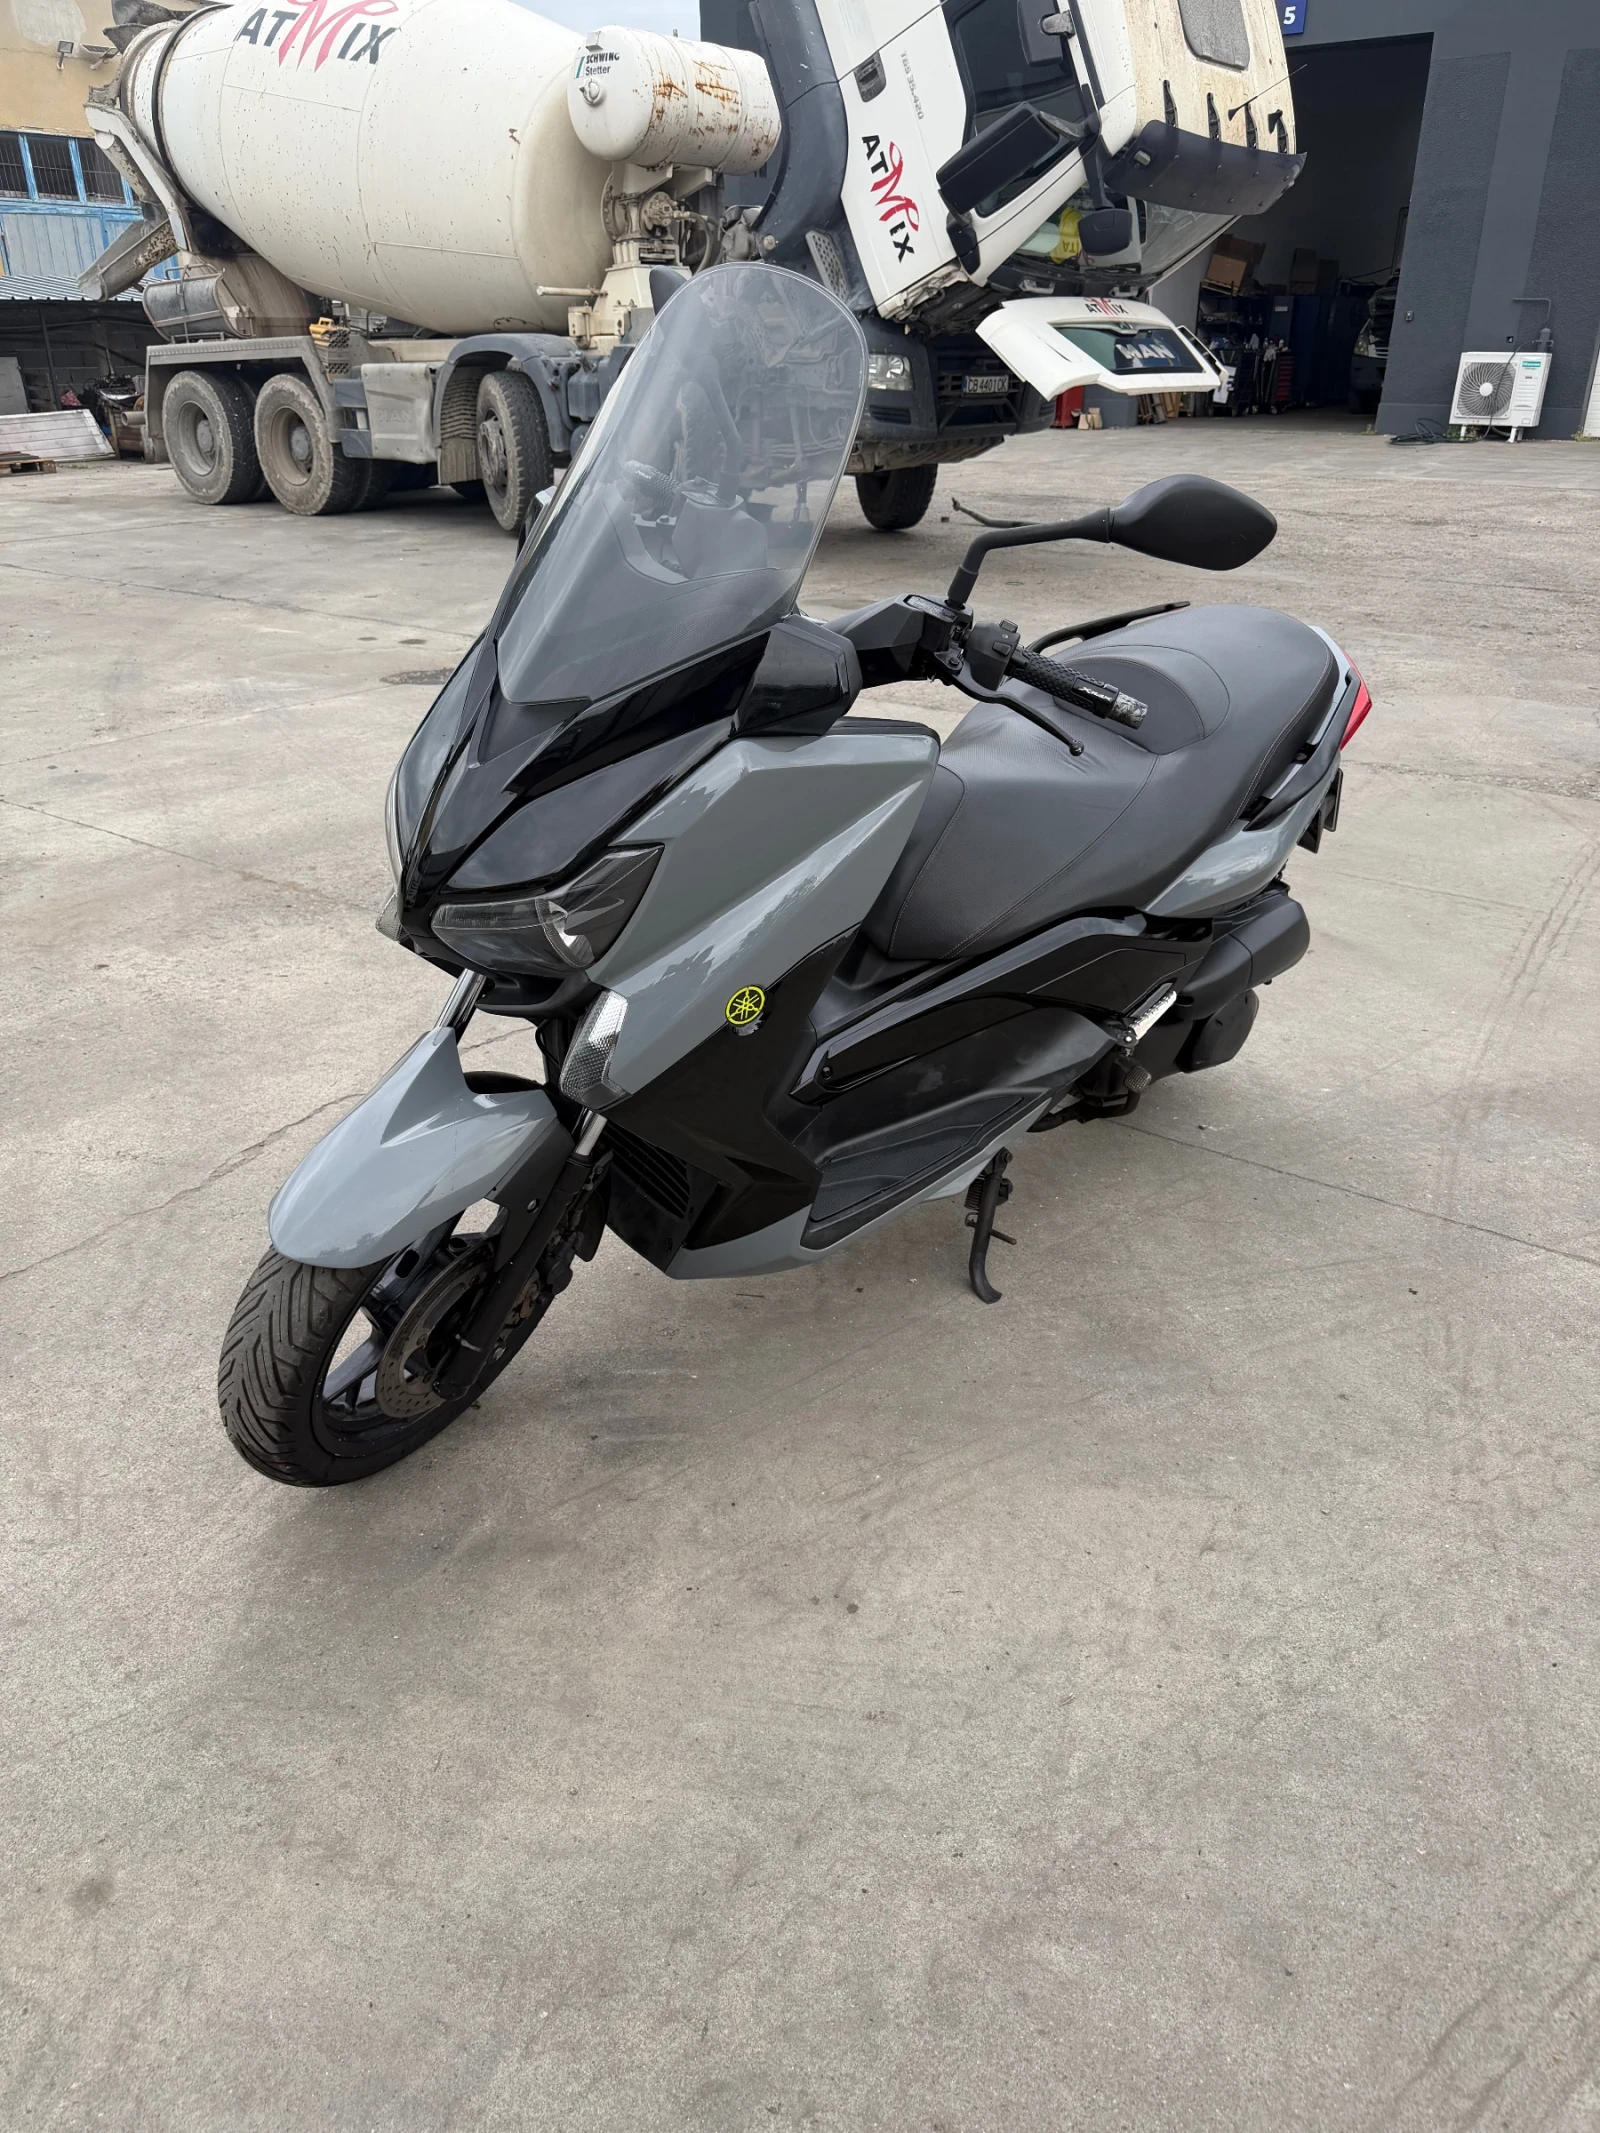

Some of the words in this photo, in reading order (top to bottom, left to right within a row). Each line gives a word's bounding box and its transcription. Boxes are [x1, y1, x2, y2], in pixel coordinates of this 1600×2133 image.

[1283, 6, 1296, 25] 5
[233, 0, 399, 73] ATMIX
[586, 52, 620, 64] SCHWING
[586, 66, 611, 76] Stetter
[861, 135, 919, 263] ATMIX
[1084, 297, 1128, 316] ATMIX
[1115, 344, 1175, 359] MAN
